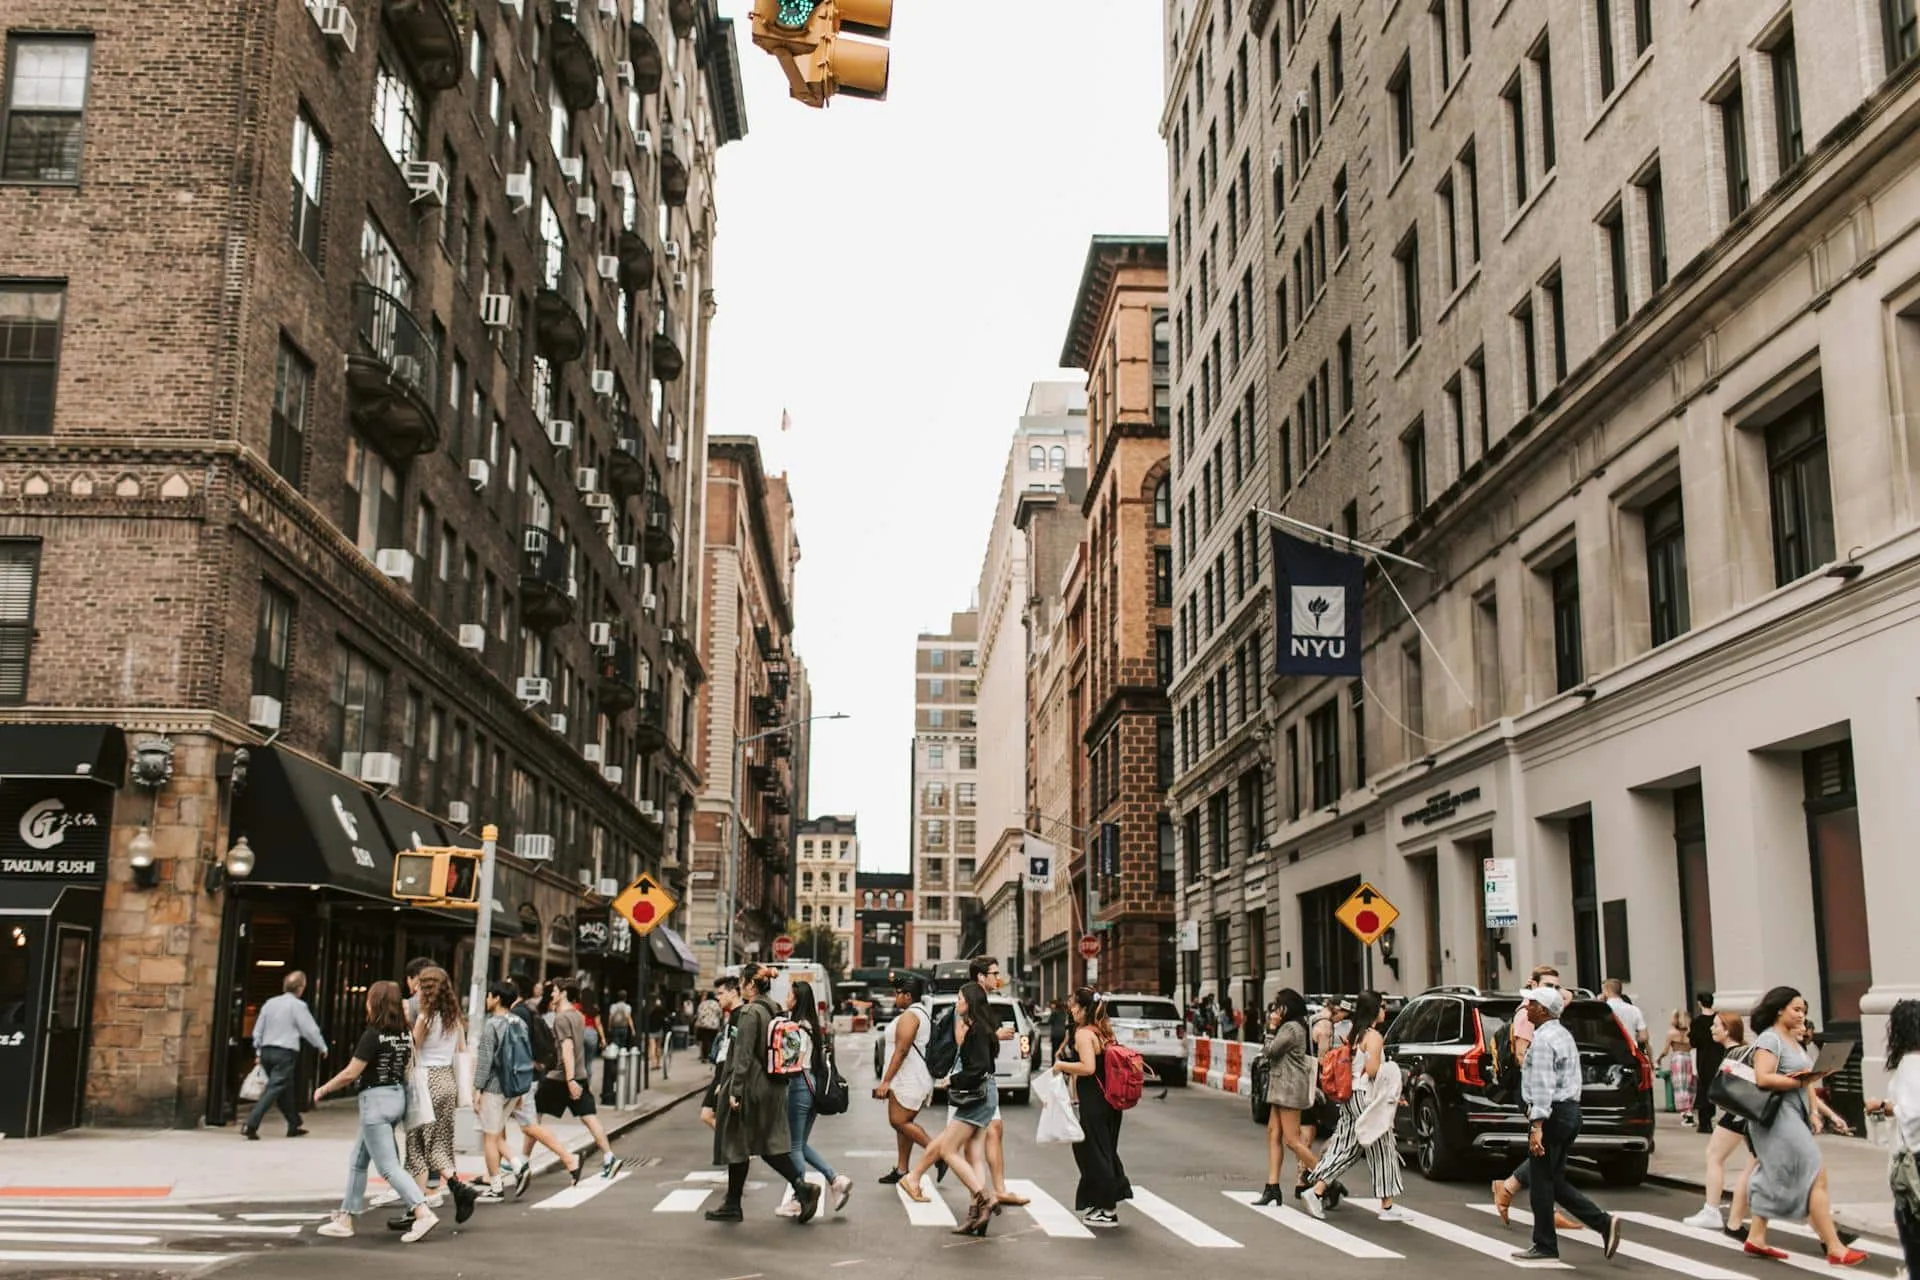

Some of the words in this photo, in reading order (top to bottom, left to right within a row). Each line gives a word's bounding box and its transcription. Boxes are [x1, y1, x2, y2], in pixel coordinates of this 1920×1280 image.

[1291, 638, 1345, 658] NYU
[1, 860, 54, 873] TAKUMI
[57, 861, 96, 873] SUSHI
